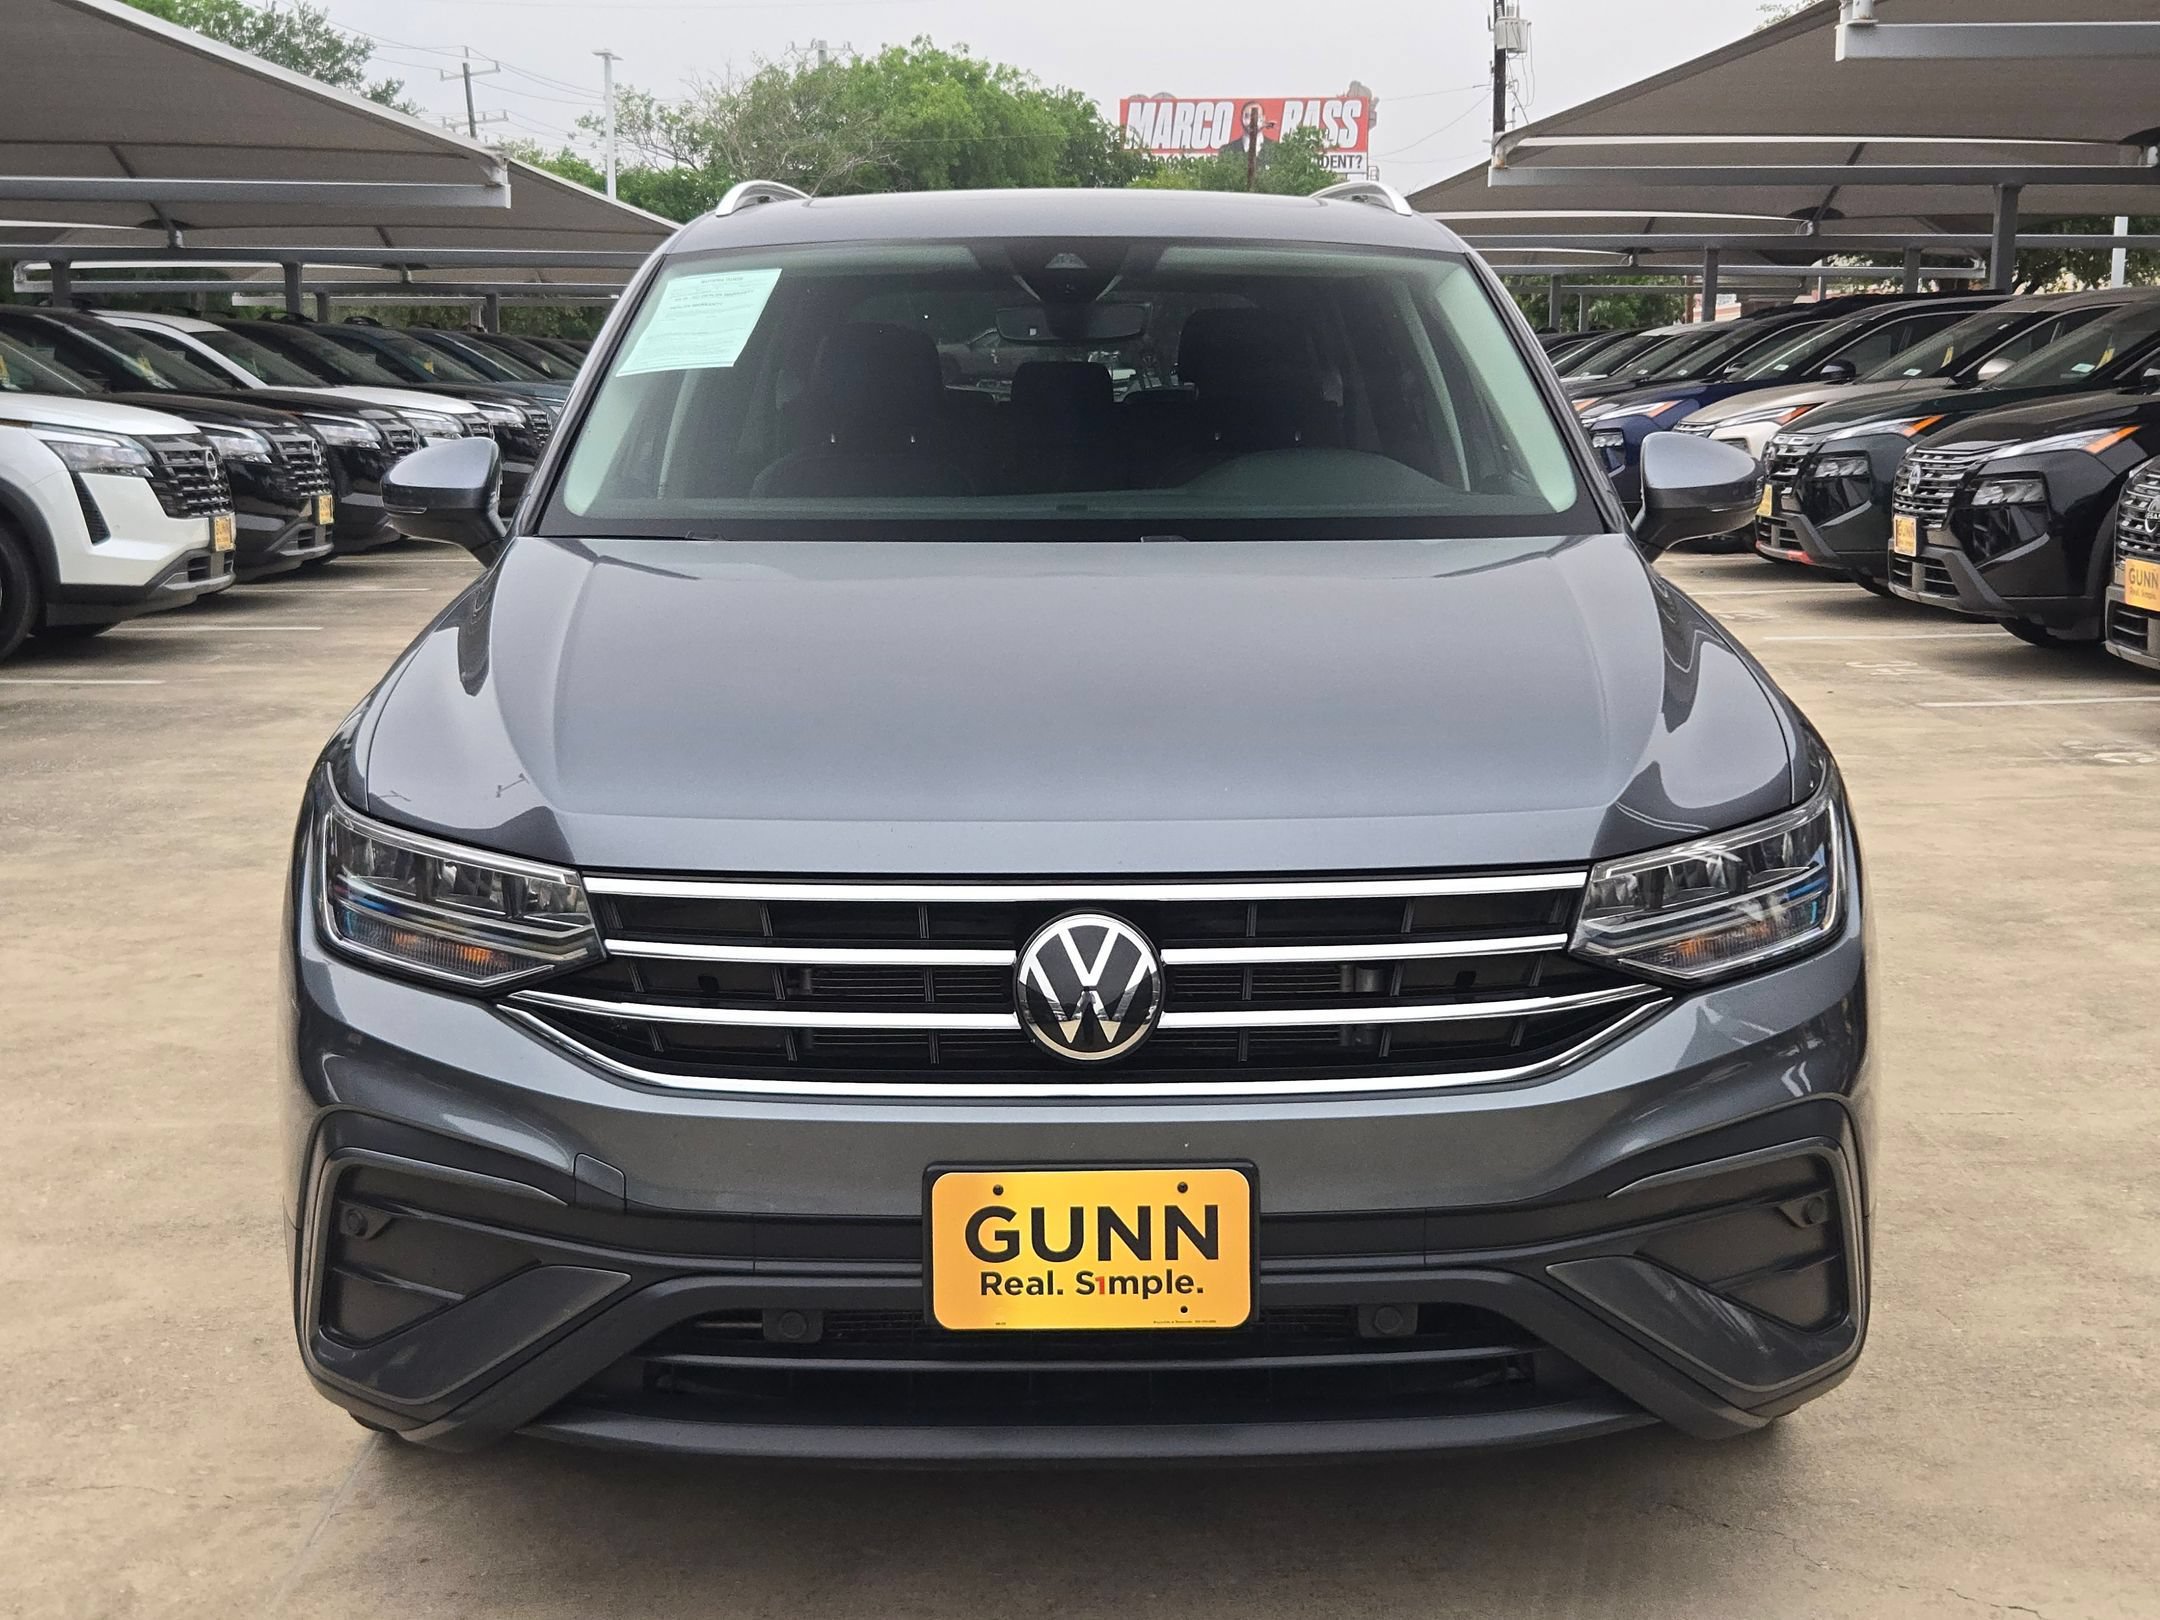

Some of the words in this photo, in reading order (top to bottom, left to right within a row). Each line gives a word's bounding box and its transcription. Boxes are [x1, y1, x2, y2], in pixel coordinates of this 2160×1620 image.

[1124, 101, 1234, 149] MARCO
[2128, 567, 2159, 589] GUNN
[965, 1205, 1219, 1263] GUNN
[980, 1270, 1064, 1296] Real.
